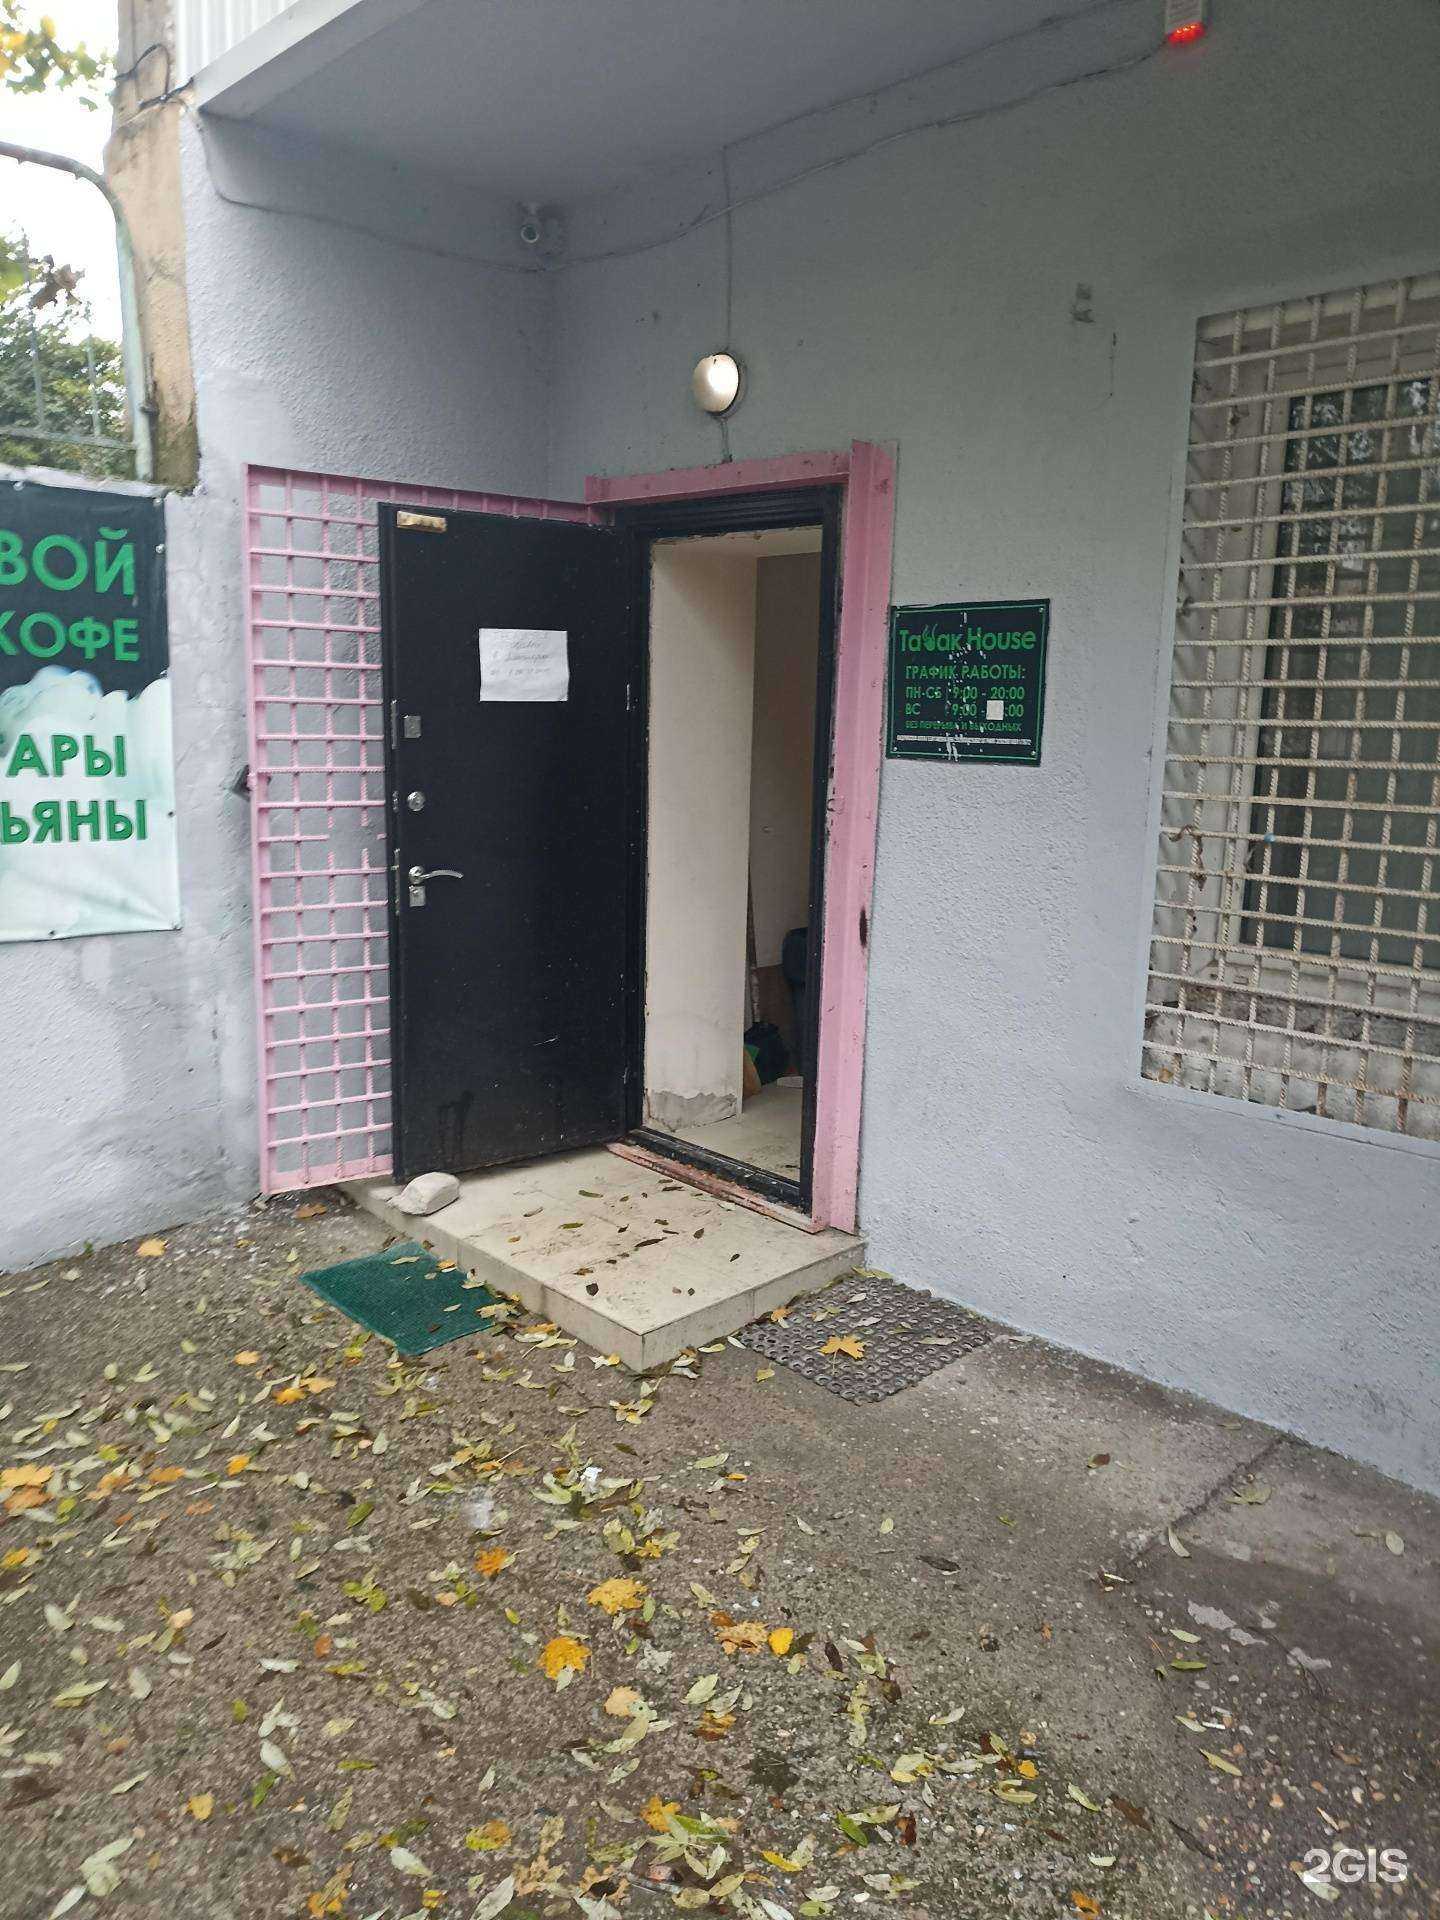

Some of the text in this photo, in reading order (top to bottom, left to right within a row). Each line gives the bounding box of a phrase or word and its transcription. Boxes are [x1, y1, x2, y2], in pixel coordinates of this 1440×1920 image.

[0, 526, 136, 596] ВОЙ
[966, 627, 1037, 652] House
[905, 664, 1026, 680] ГРАФИК РАБОТЫ:
[952, 686, 978, 700] 9:00
[990, 686, 1025, 700] 20:00
[905, 703, 921, 716] ВС
[951, 703, 977, 717] 9:00
[0, 732, 126, 778] АРЫ
[0, 799, 147, 844] ЬЯНЫ
